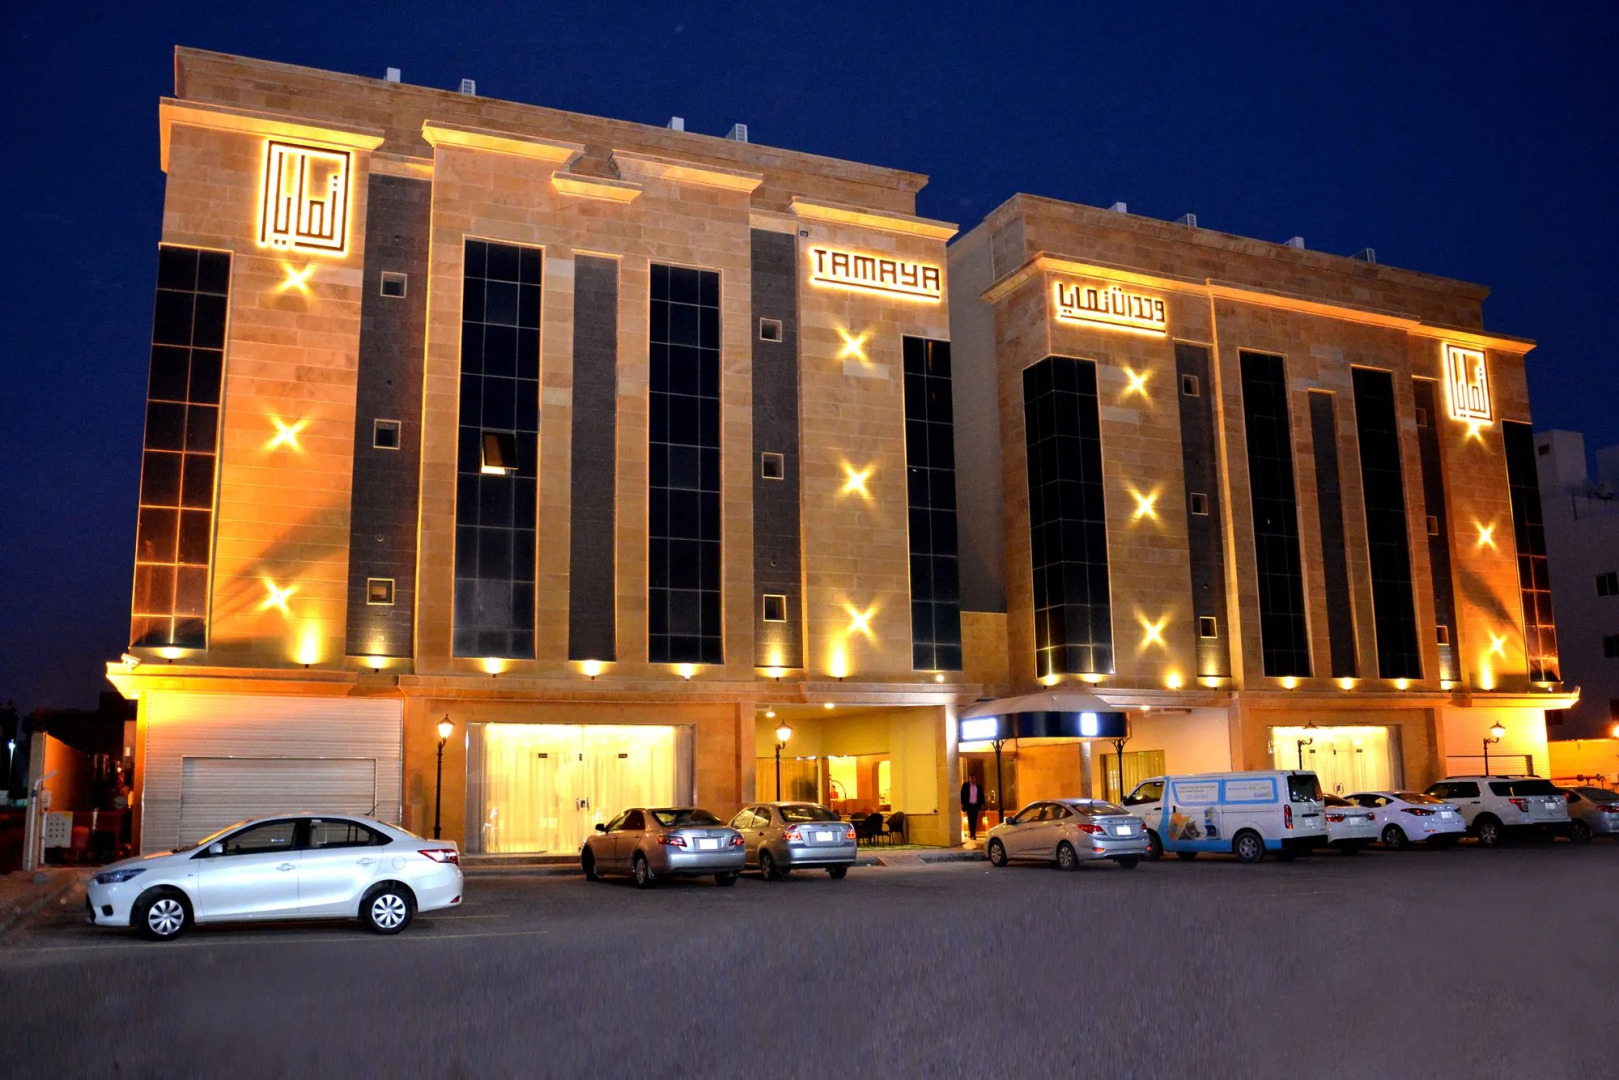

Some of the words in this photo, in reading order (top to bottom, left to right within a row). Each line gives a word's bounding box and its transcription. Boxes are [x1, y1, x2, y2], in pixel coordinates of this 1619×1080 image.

[813, 248, 940, 291] TAMAYA
[1058, 283, 1110, 314] تمايا
[1111, 286, 1166, 323] وحدات
